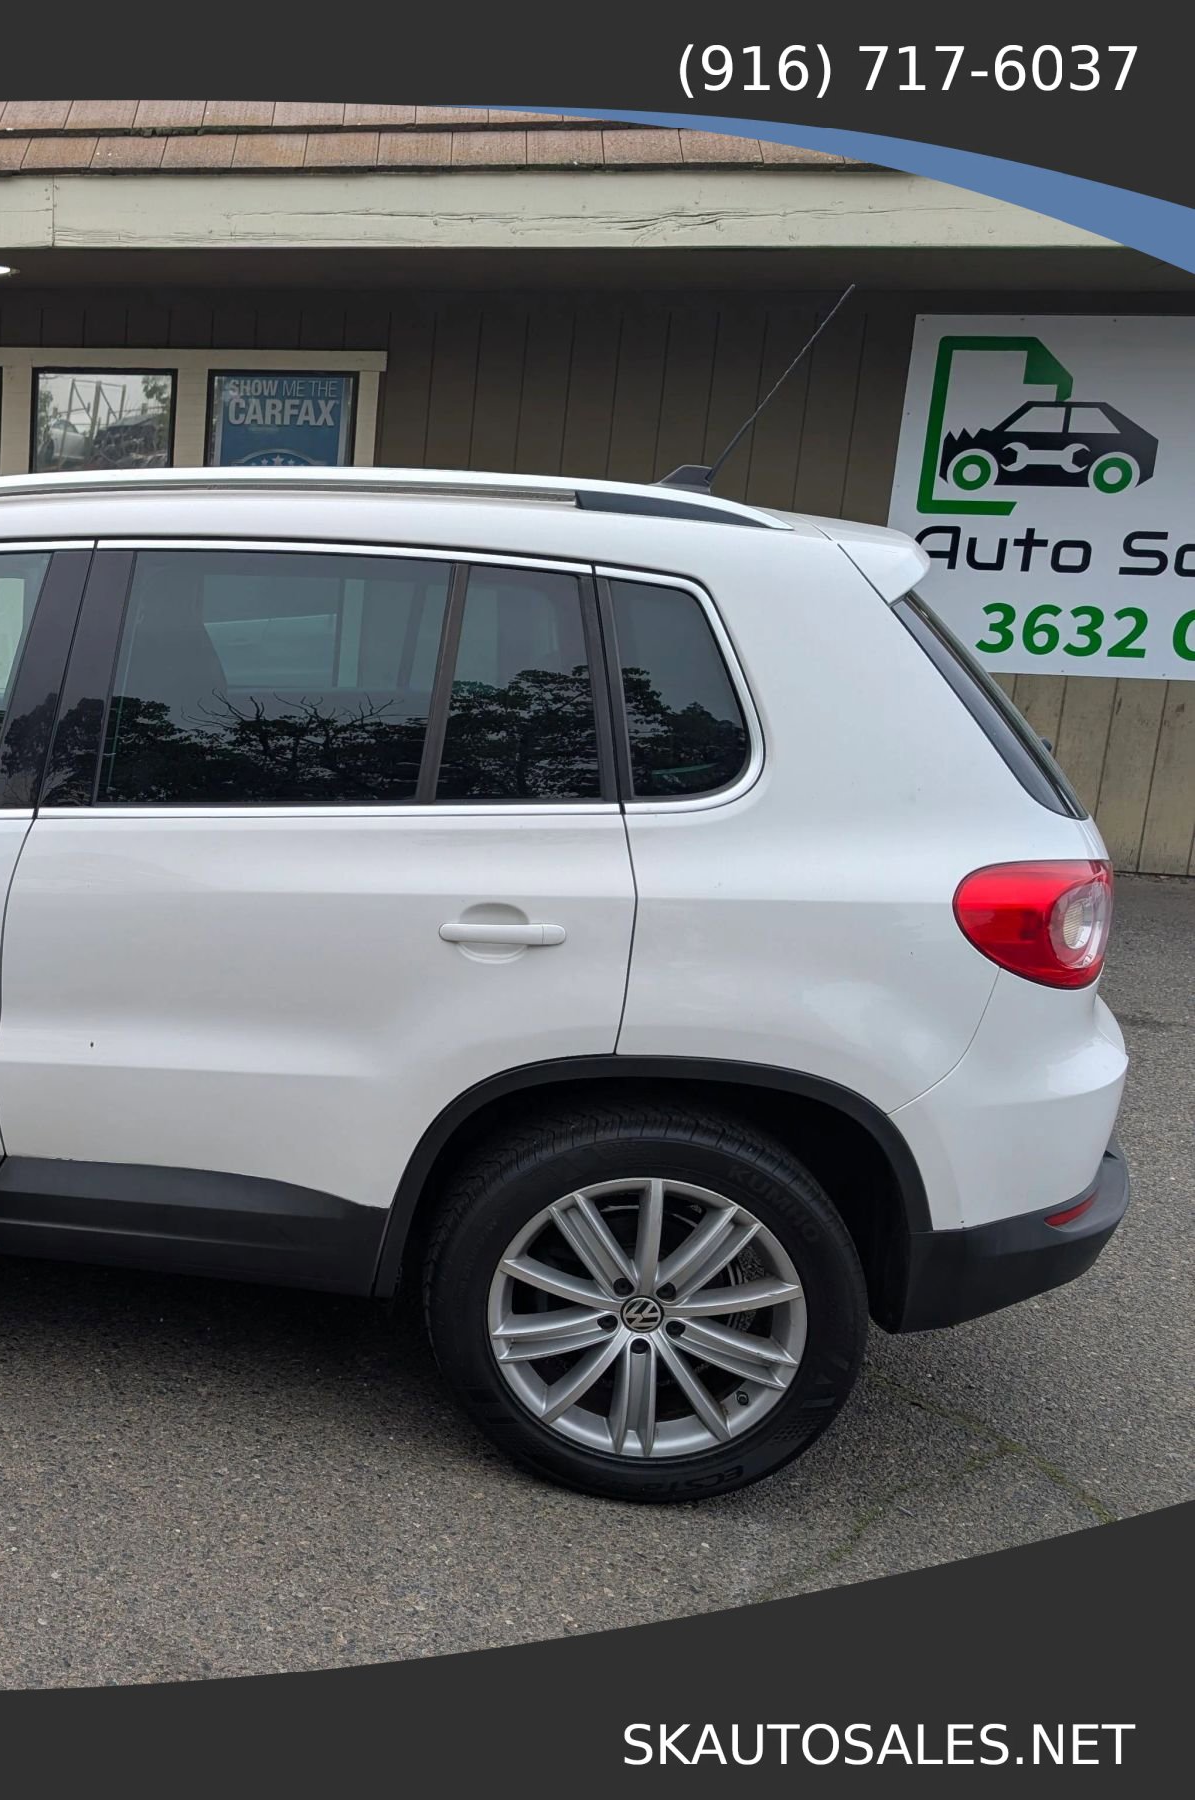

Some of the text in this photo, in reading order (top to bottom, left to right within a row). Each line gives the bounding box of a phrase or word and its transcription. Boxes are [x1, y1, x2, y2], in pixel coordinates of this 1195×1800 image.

[228, 379, 338, 398] SHOW ME THE
[228, 399, 336, 426] CARFAX
[914, 525, 1092, 574] Auto
[974, 602, 1149, 659] 3632
